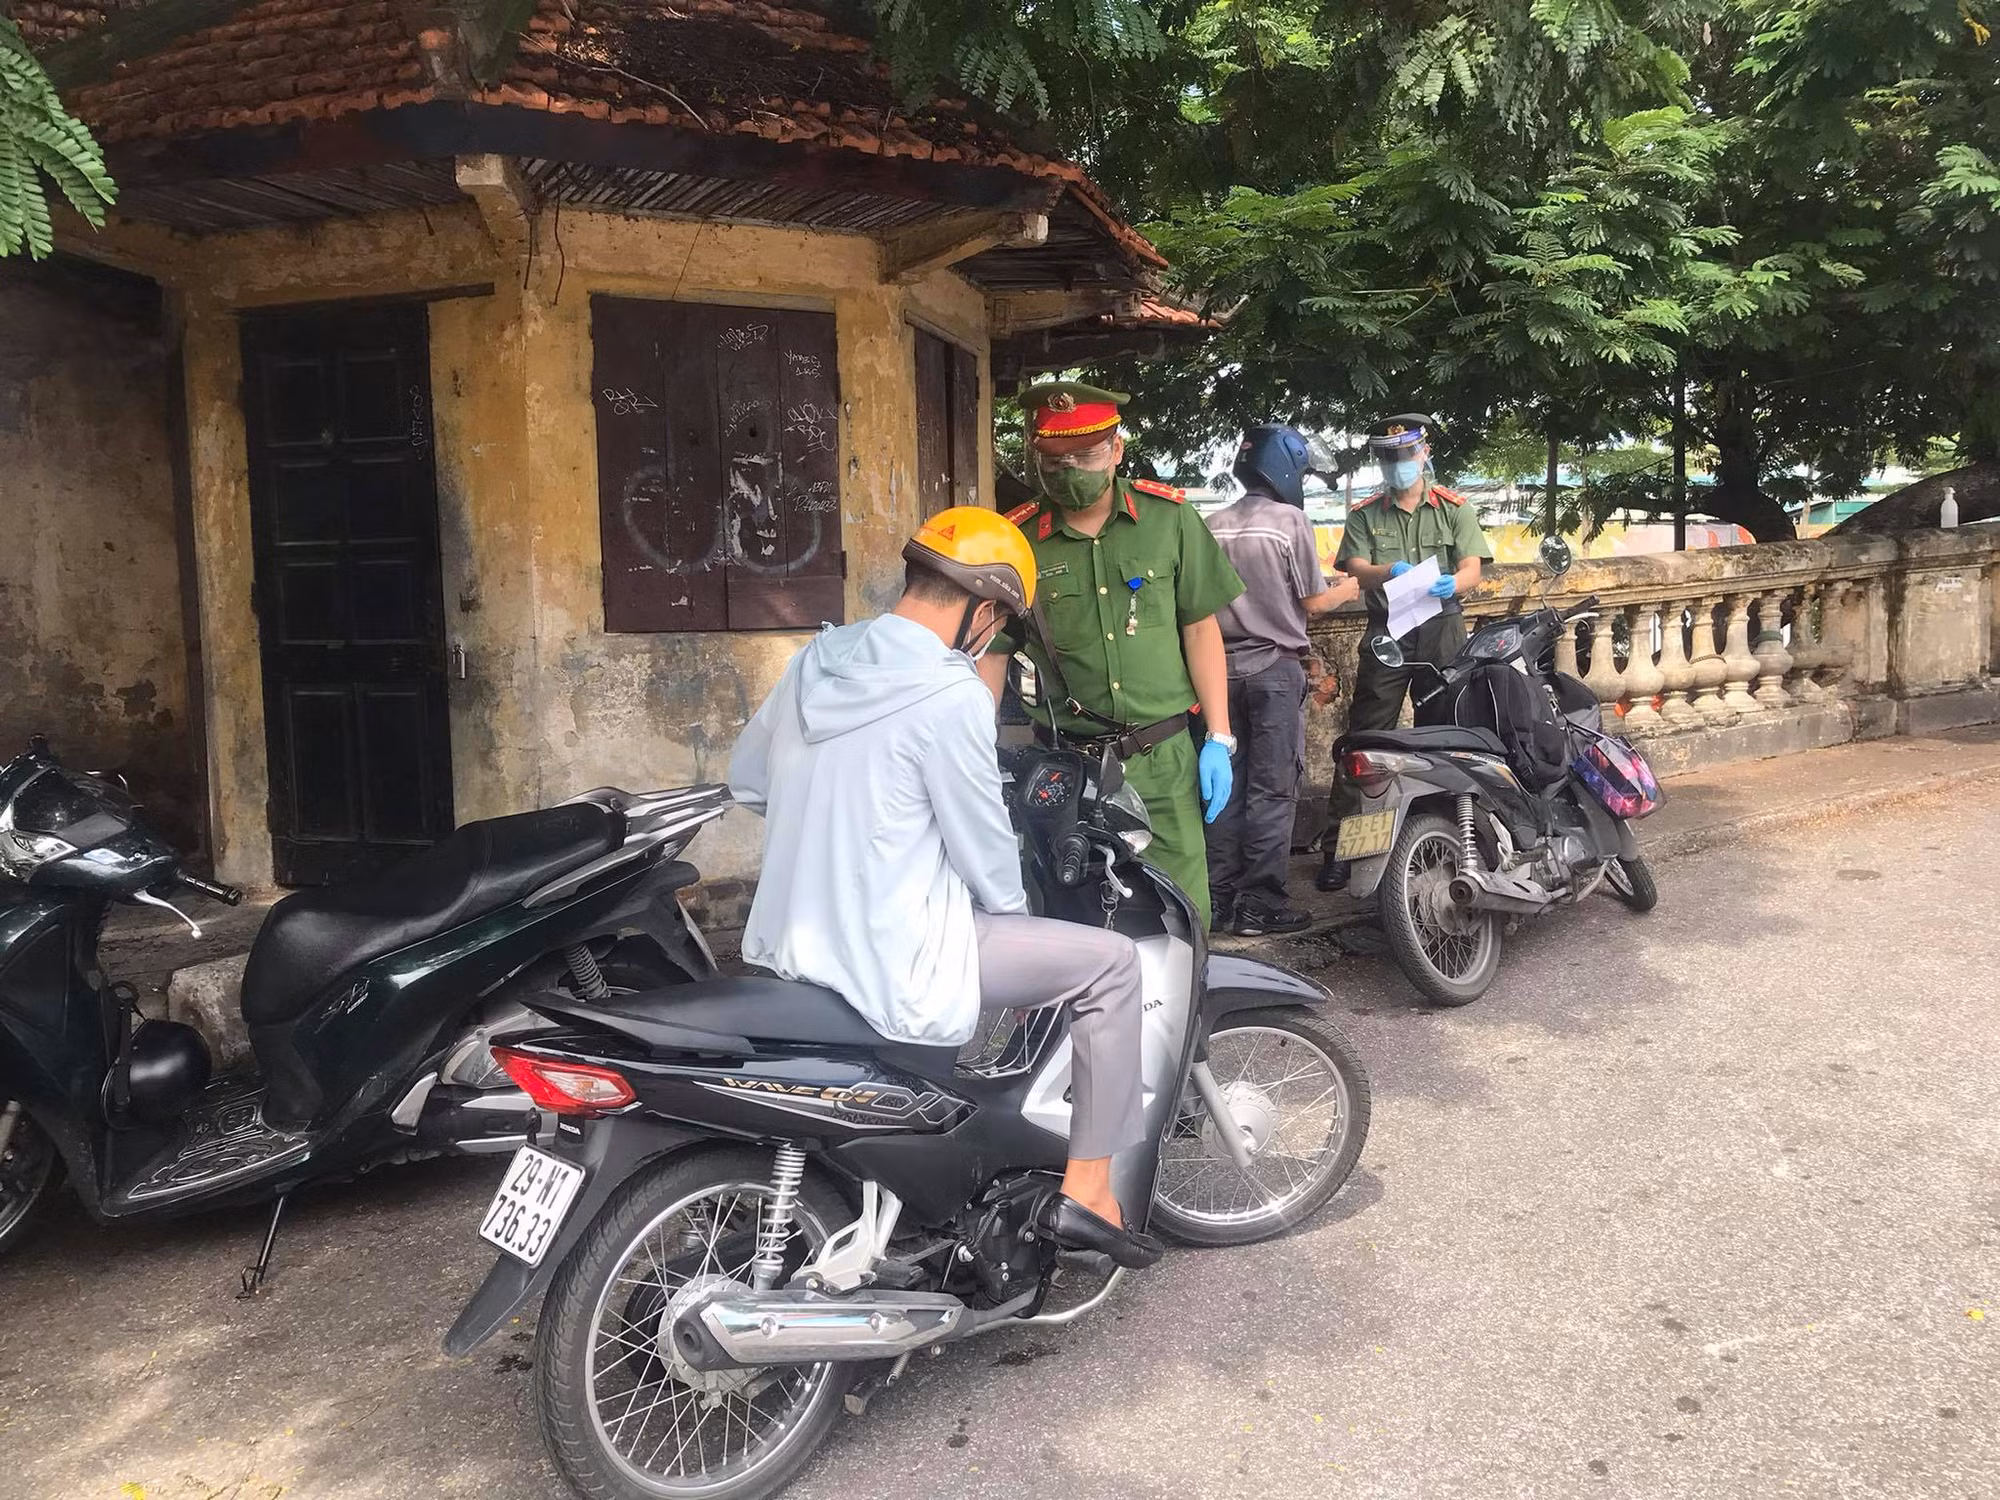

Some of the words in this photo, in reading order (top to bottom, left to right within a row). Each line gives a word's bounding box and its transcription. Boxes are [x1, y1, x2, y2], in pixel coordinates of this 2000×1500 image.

[723, 1077, 821, 1095] WAVE
[510, 1153, 570, 1210] 29-N1
[483, 1193, 551, 1257] 736.33
